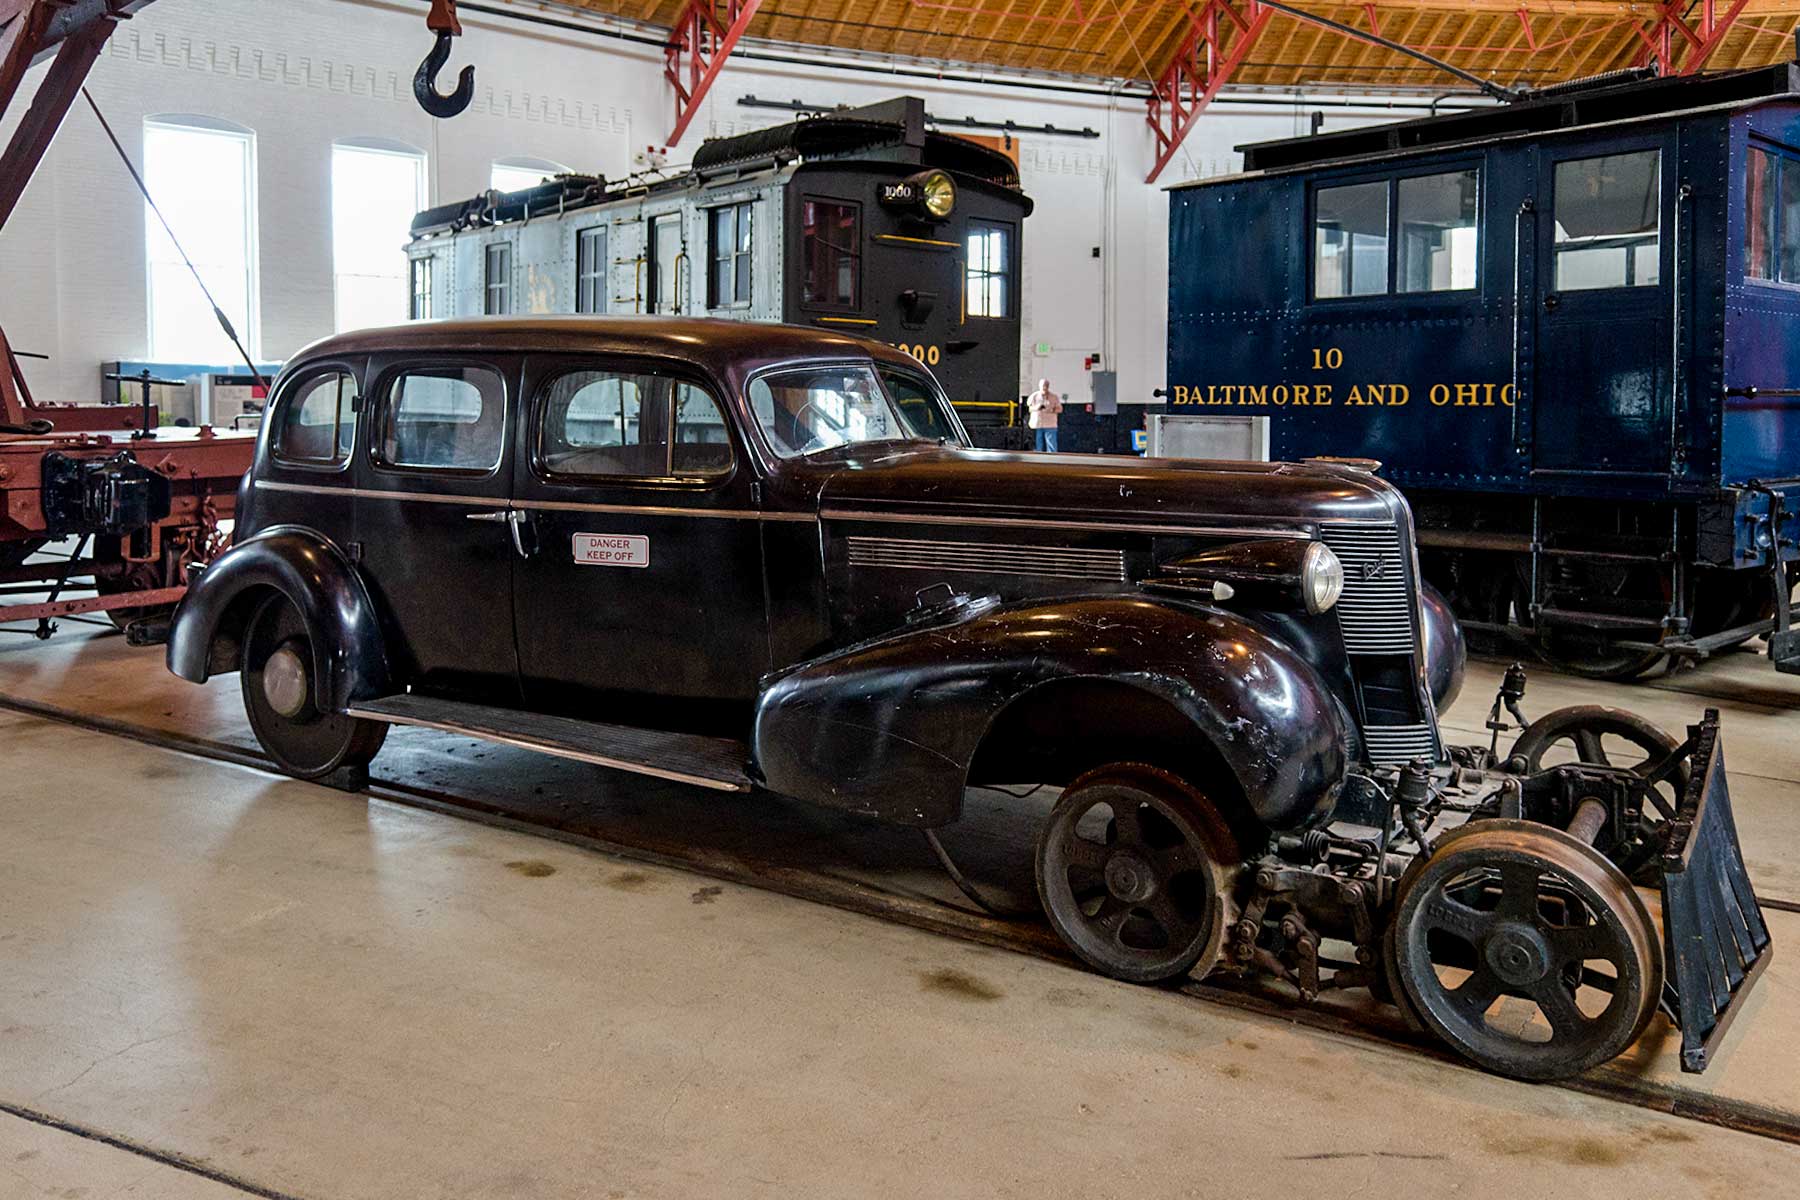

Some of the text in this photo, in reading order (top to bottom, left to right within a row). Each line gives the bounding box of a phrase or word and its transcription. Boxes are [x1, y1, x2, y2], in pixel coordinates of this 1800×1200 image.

[885, 185, 911, 198] 1000
[1312, 348, 1343, 370] 10
[1173, 383, 1521, 407] BALTIMORE AND OHIO
[590, 539, 630, 549] DANGER
[586, 550, 634, 561] KEEP OFF
